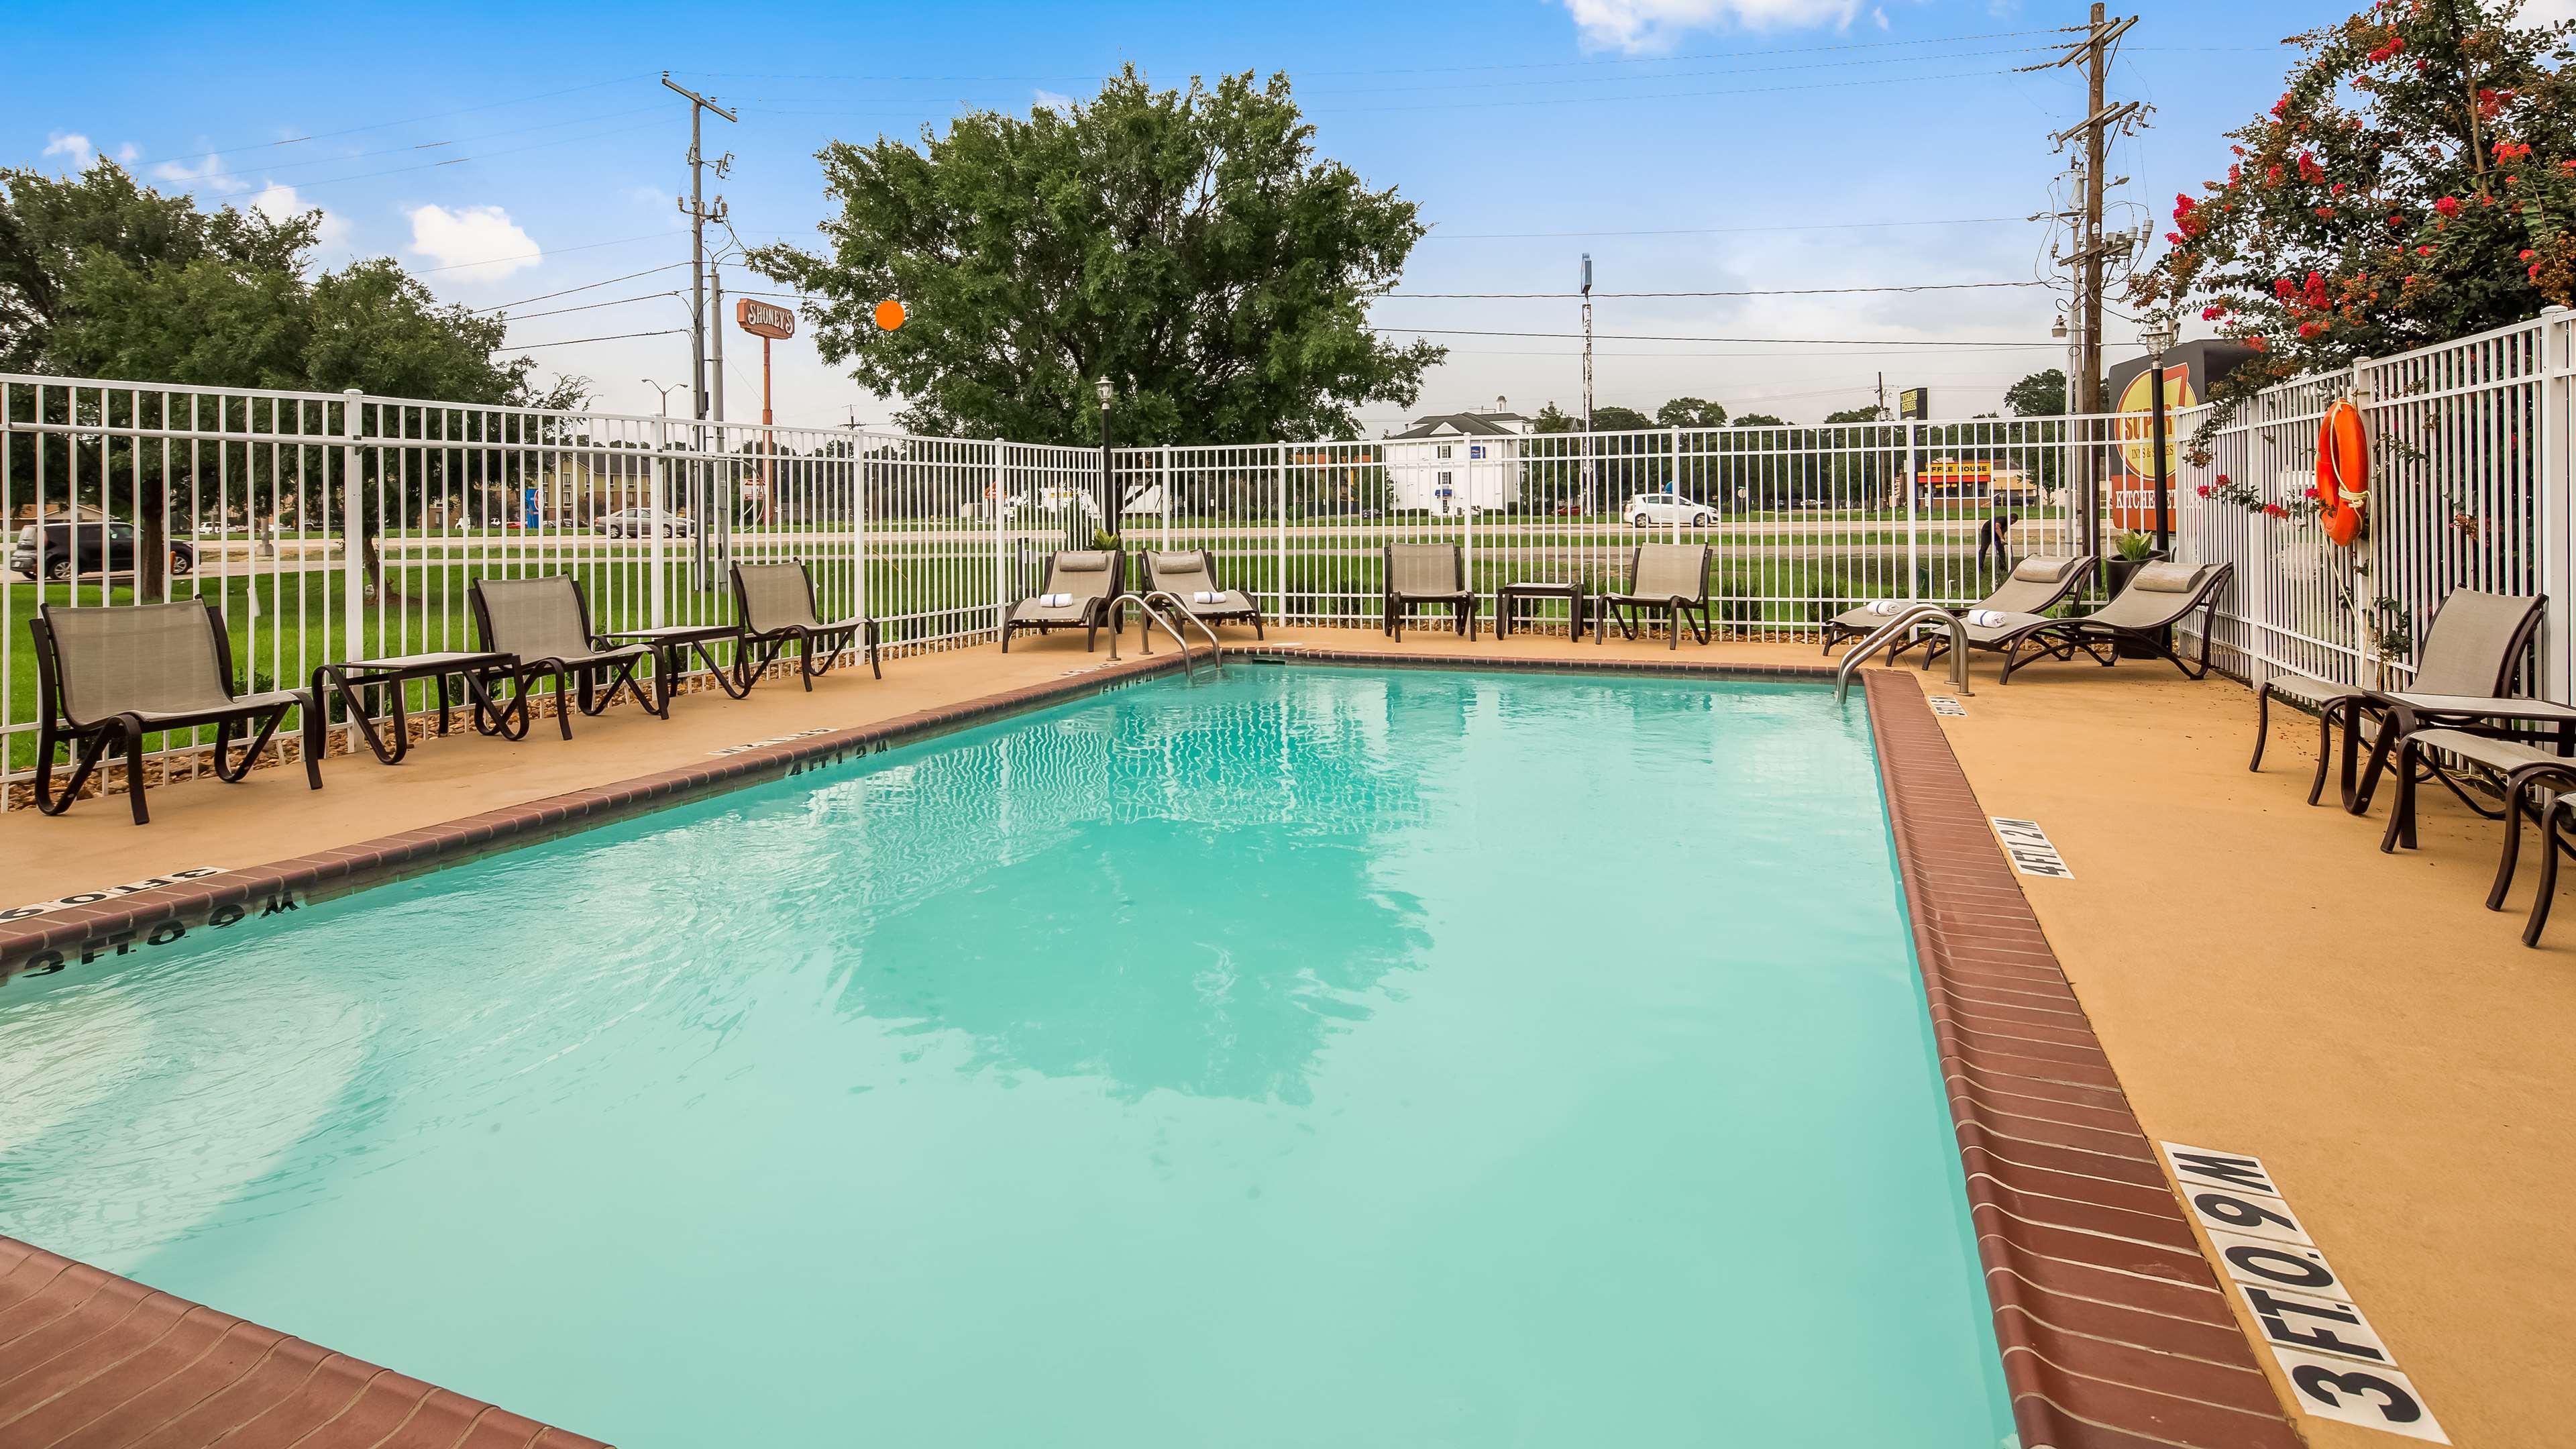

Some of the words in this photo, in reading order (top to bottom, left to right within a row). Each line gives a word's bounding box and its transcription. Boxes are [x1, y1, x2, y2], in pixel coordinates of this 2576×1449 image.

[748, 304, 794, 334] SHONEY'S
[2125, 404, 2172, 441] SUPR
[788, 761, 804, 777] 4
[1994, 819, 2039, 830] M
[172, 868, 217, 879] 3
[2020, 864, 2067, 875] 4
[23, 950, 66, 978] 3
[2172, 1152, 2275, 1193] M
[2245, 1286, 2385, 1362] FT.
[2292, 1364, 2421, 1424] 3
